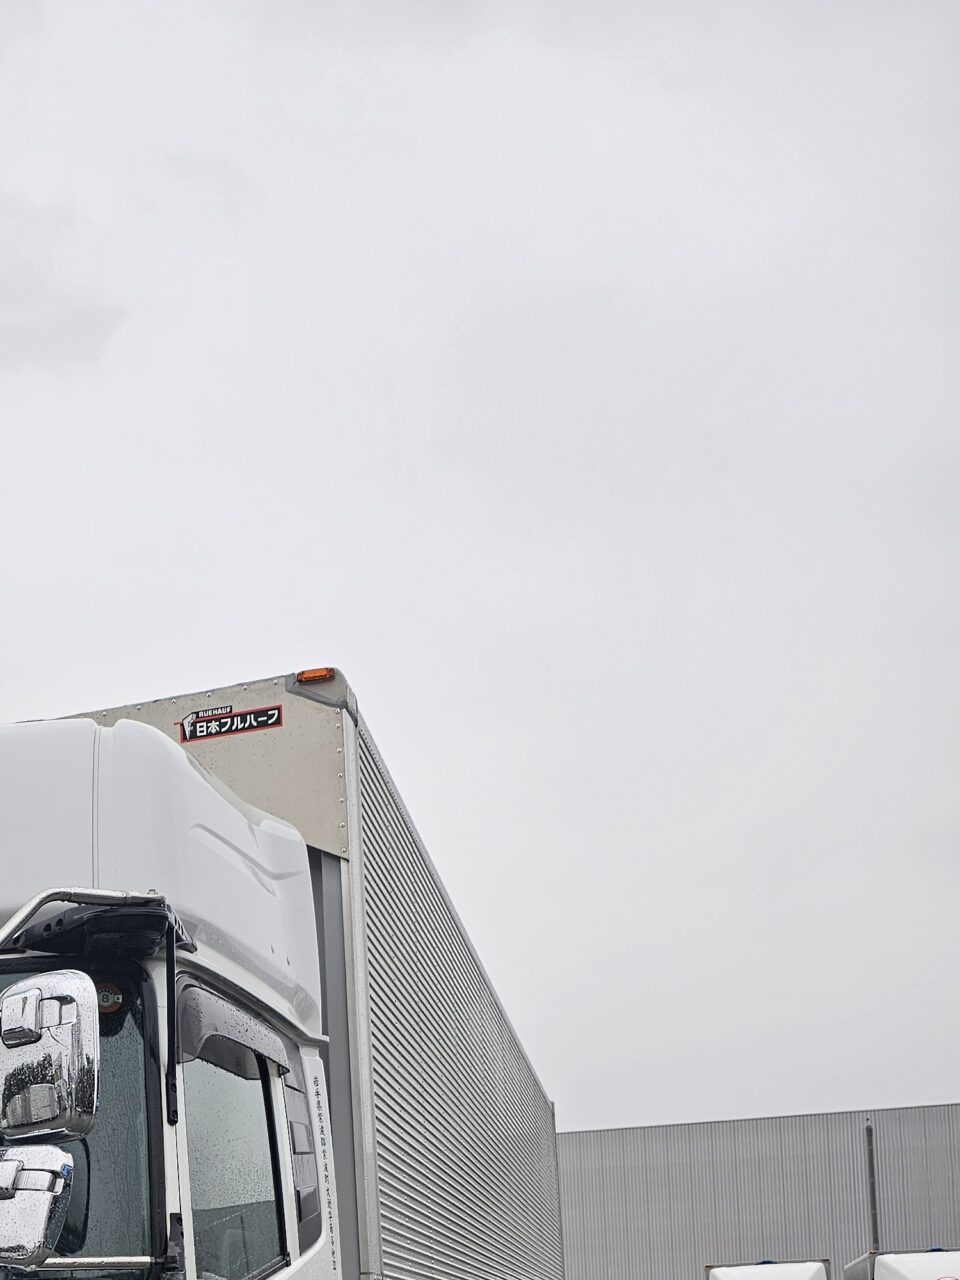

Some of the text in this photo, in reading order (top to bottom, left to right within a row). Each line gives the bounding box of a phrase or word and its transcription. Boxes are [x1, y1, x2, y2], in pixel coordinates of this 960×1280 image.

[196, 710, 279, 737] 日本フルハーフ
